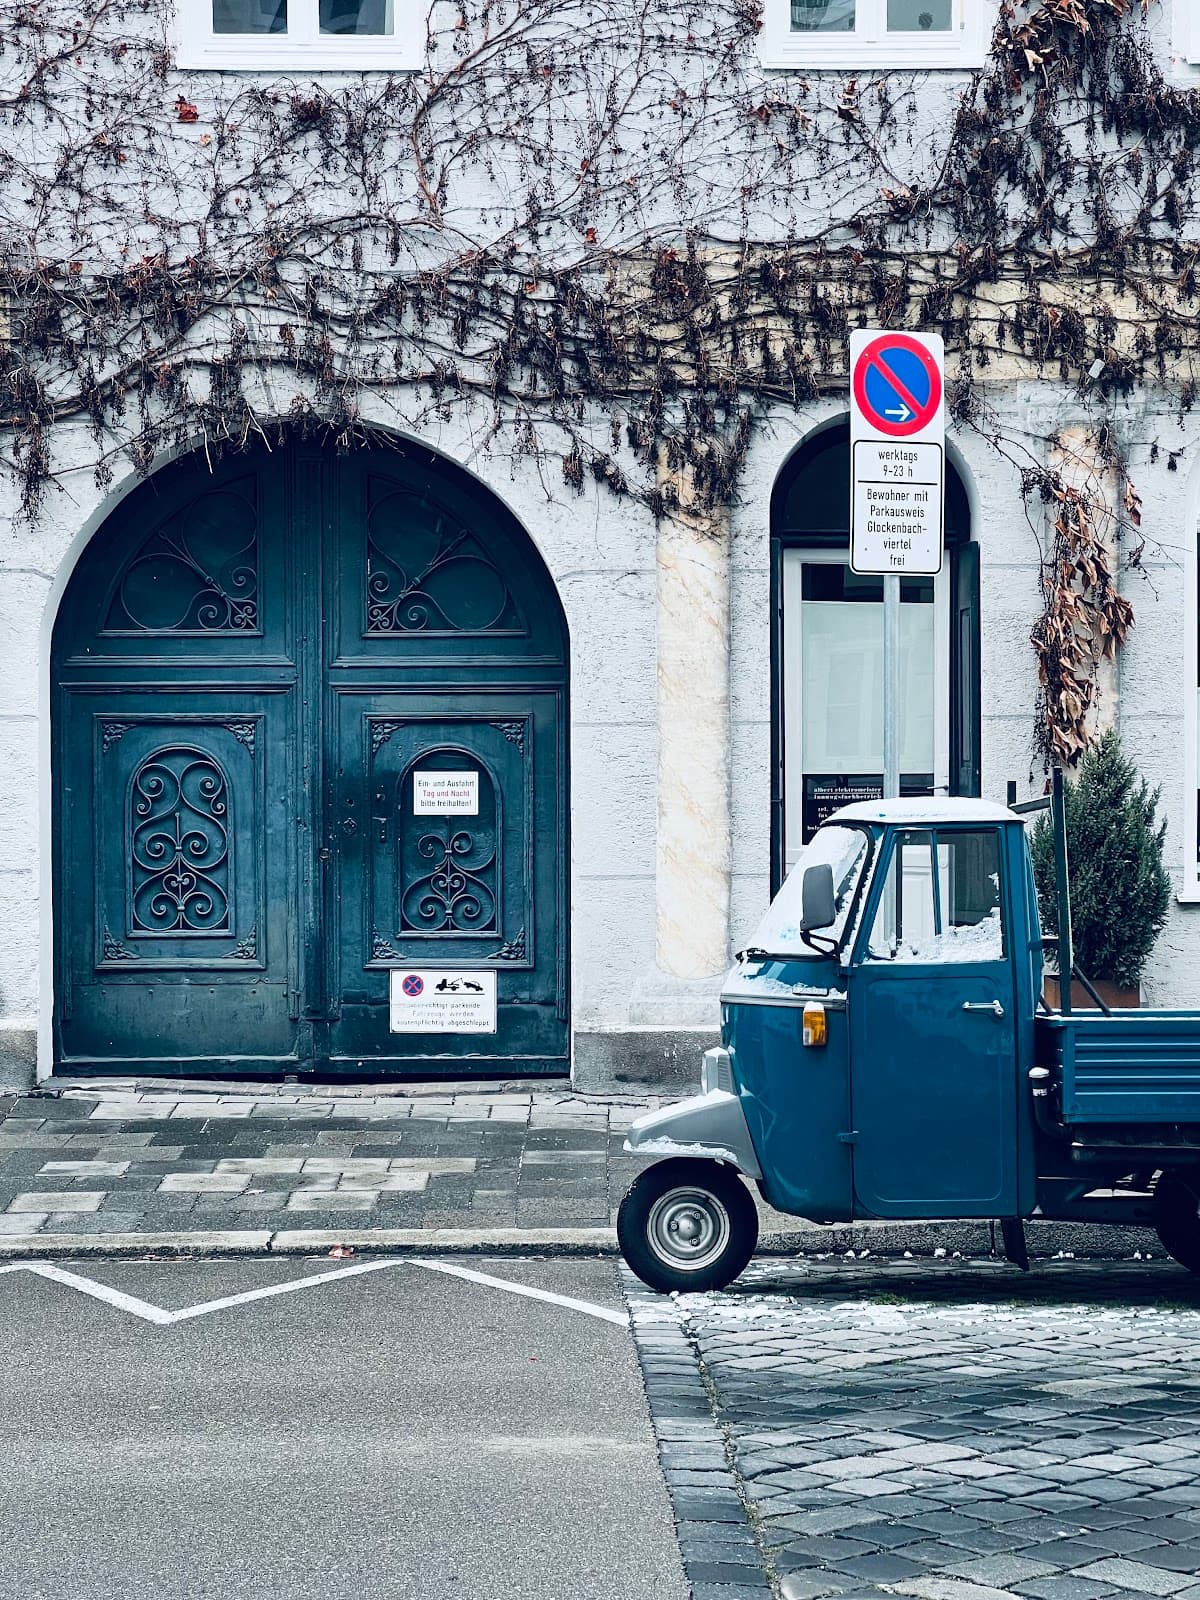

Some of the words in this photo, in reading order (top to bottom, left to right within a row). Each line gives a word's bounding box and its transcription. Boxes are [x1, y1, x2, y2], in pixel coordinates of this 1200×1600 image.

[879, 449, 918, 463] werktags
[883, 464, 904, 477] 9-23
[908, 466, 913, 477] h
[867, 488, 910, 501] Bewohner
[914, 490, 929, 502] mit
[870, 505, 925, 518] Parkausweis
[867, 521, 928, 534] Glockenbach-
[883, 537, 911, 549] viertel
[890, 554, 905, 566] frei
[423, 790, 435, 798] Tag
[420, 799, 436, 807] bitte
[437, 799, 472, 807] freihalten!
[450, 1002, 481, 1010] parkende
